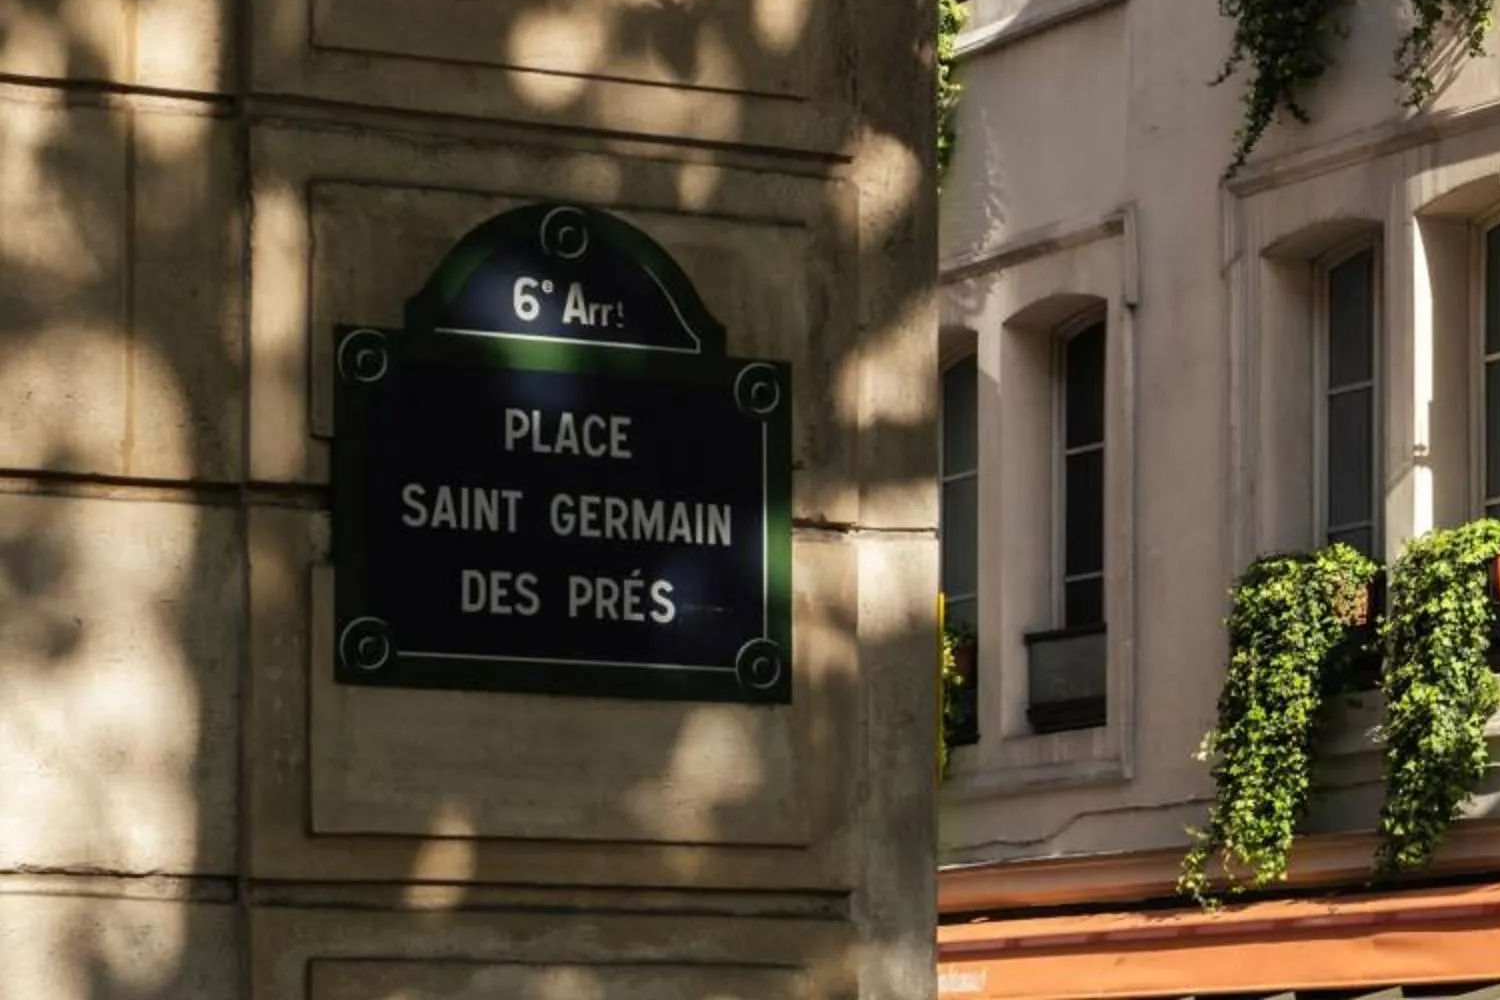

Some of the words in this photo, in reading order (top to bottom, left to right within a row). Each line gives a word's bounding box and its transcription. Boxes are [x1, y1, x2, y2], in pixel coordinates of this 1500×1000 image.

[504, 408, 632, 458] PLACE
[402, 484, 522, 533] SAINT
[549, 494, 732, 546] GERMAIN
[461, 570, 540, 615] DES
[569, 569, 677, 624] PRÉS
